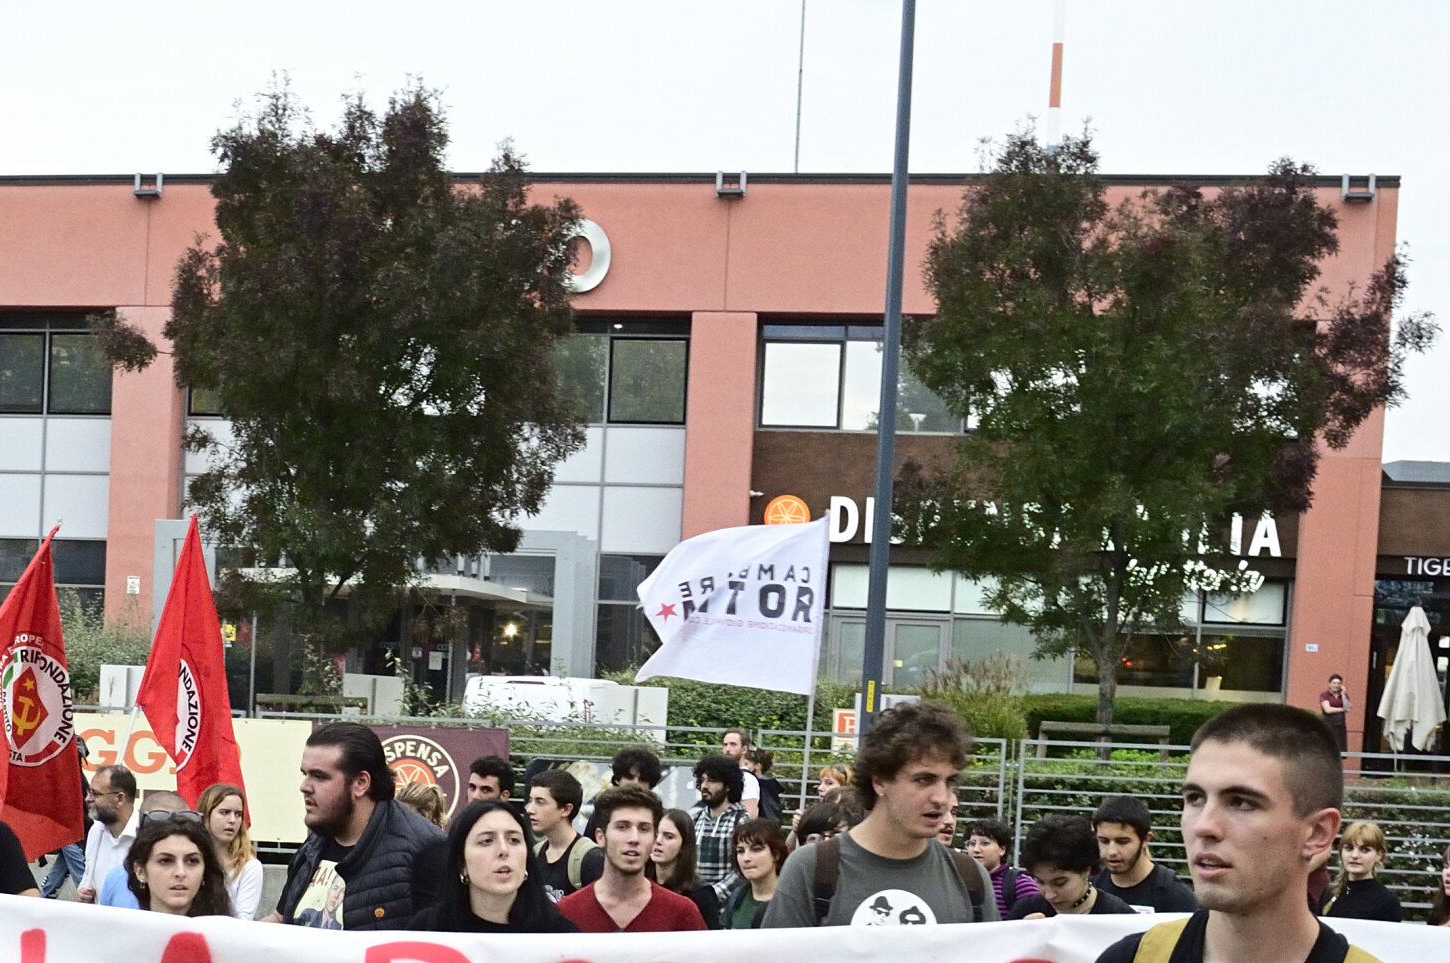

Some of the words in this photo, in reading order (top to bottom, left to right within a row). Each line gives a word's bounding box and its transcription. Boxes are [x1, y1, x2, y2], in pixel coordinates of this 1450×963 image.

[20, 649, 74, 744] RIFONDAZIONE
[178, 662, 199, 752] NDAZIONE
[384, 741, 450, 778] SPENSA
